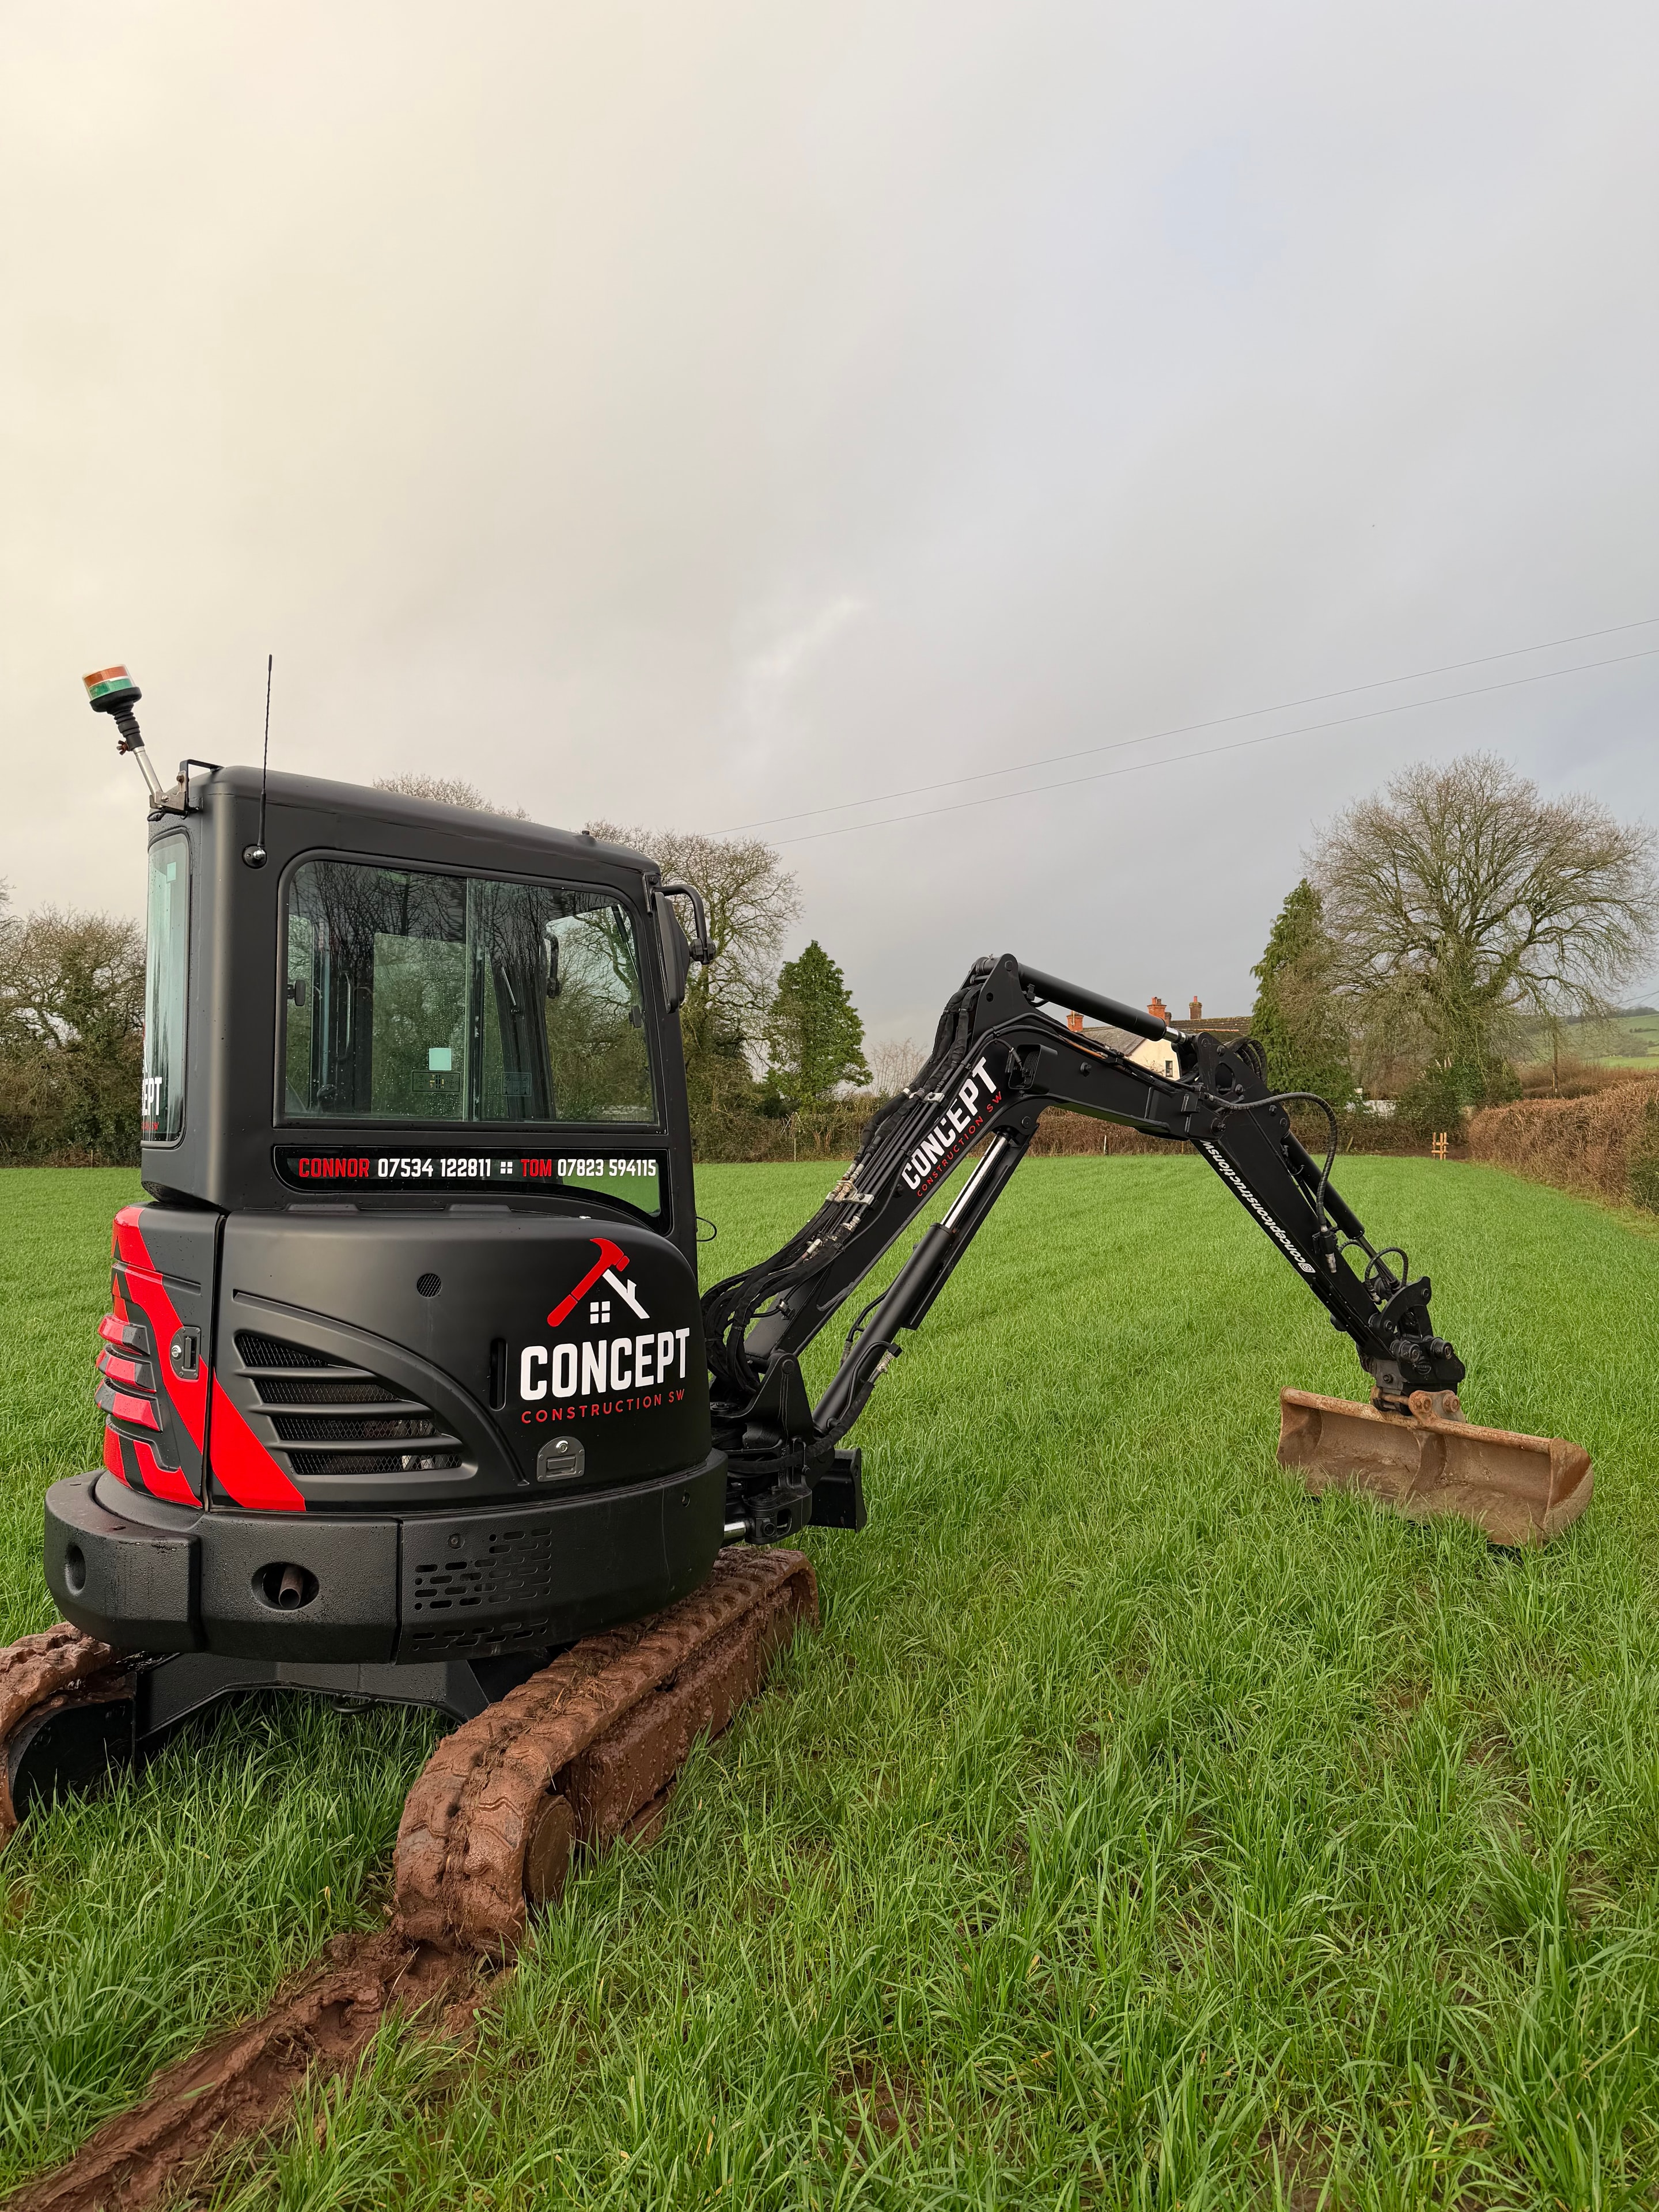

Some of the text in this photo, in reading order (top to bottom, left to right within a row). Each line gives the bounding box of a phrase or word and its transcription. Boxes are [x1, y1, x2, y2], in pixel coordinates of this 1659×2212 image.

[901, 1056, 997, 1190] CONCEPT
[916, 1091, 1003, 1197] CONSTRUCTION SW
[298, 1158, 657, 1178] CONNOR 07534 122811 TOM 07823 594115
[520, 1327, 690, 1401] CONCEPT
[521, 1388, 685, 1424] CONSTRUCTION SW
